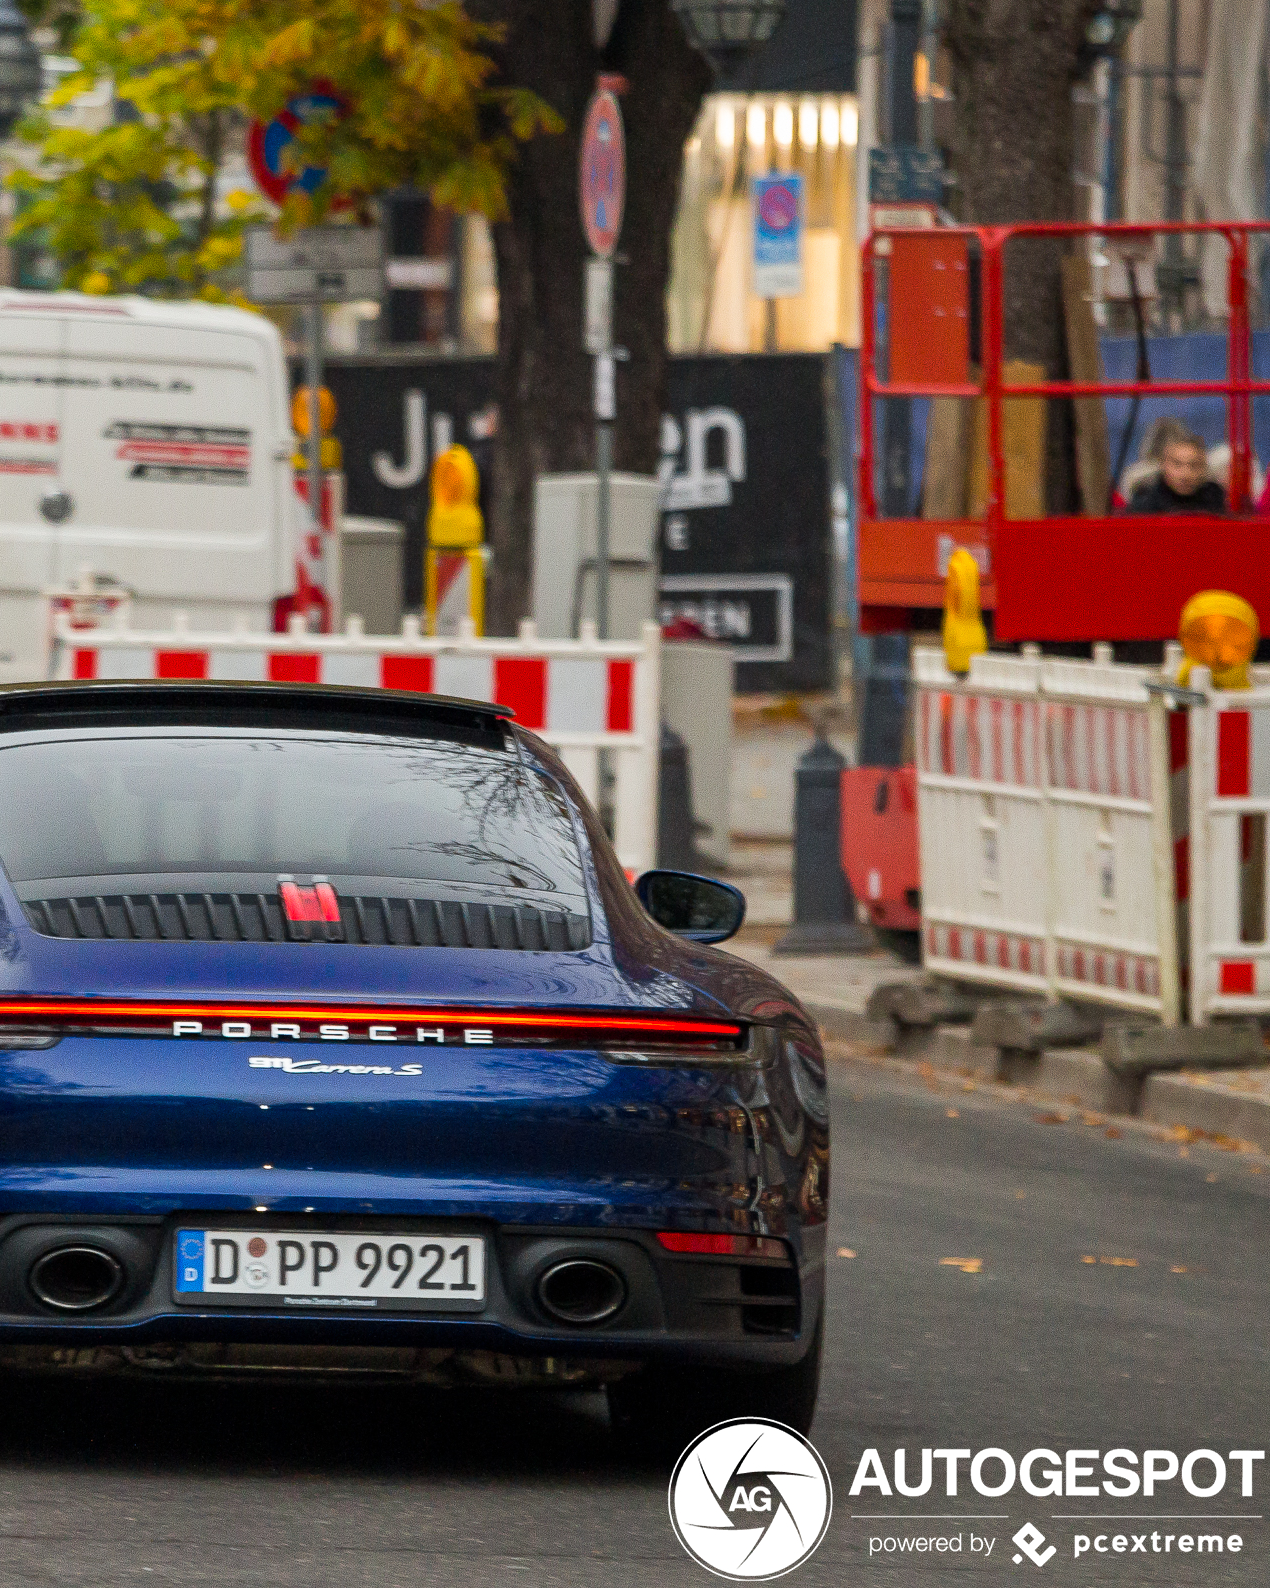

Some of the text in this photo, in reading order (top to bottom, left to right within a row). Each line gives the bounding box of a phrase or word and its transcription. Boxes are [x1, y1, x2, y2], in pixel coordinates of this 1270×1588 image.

[172, 1021, 494, 1044] PORSCHE
[248, 1056, 423, 1076] 911 Carrera S
[183, 1266, 199, 1281] D
[210, 1238, 477, 1292] D PP 9921
